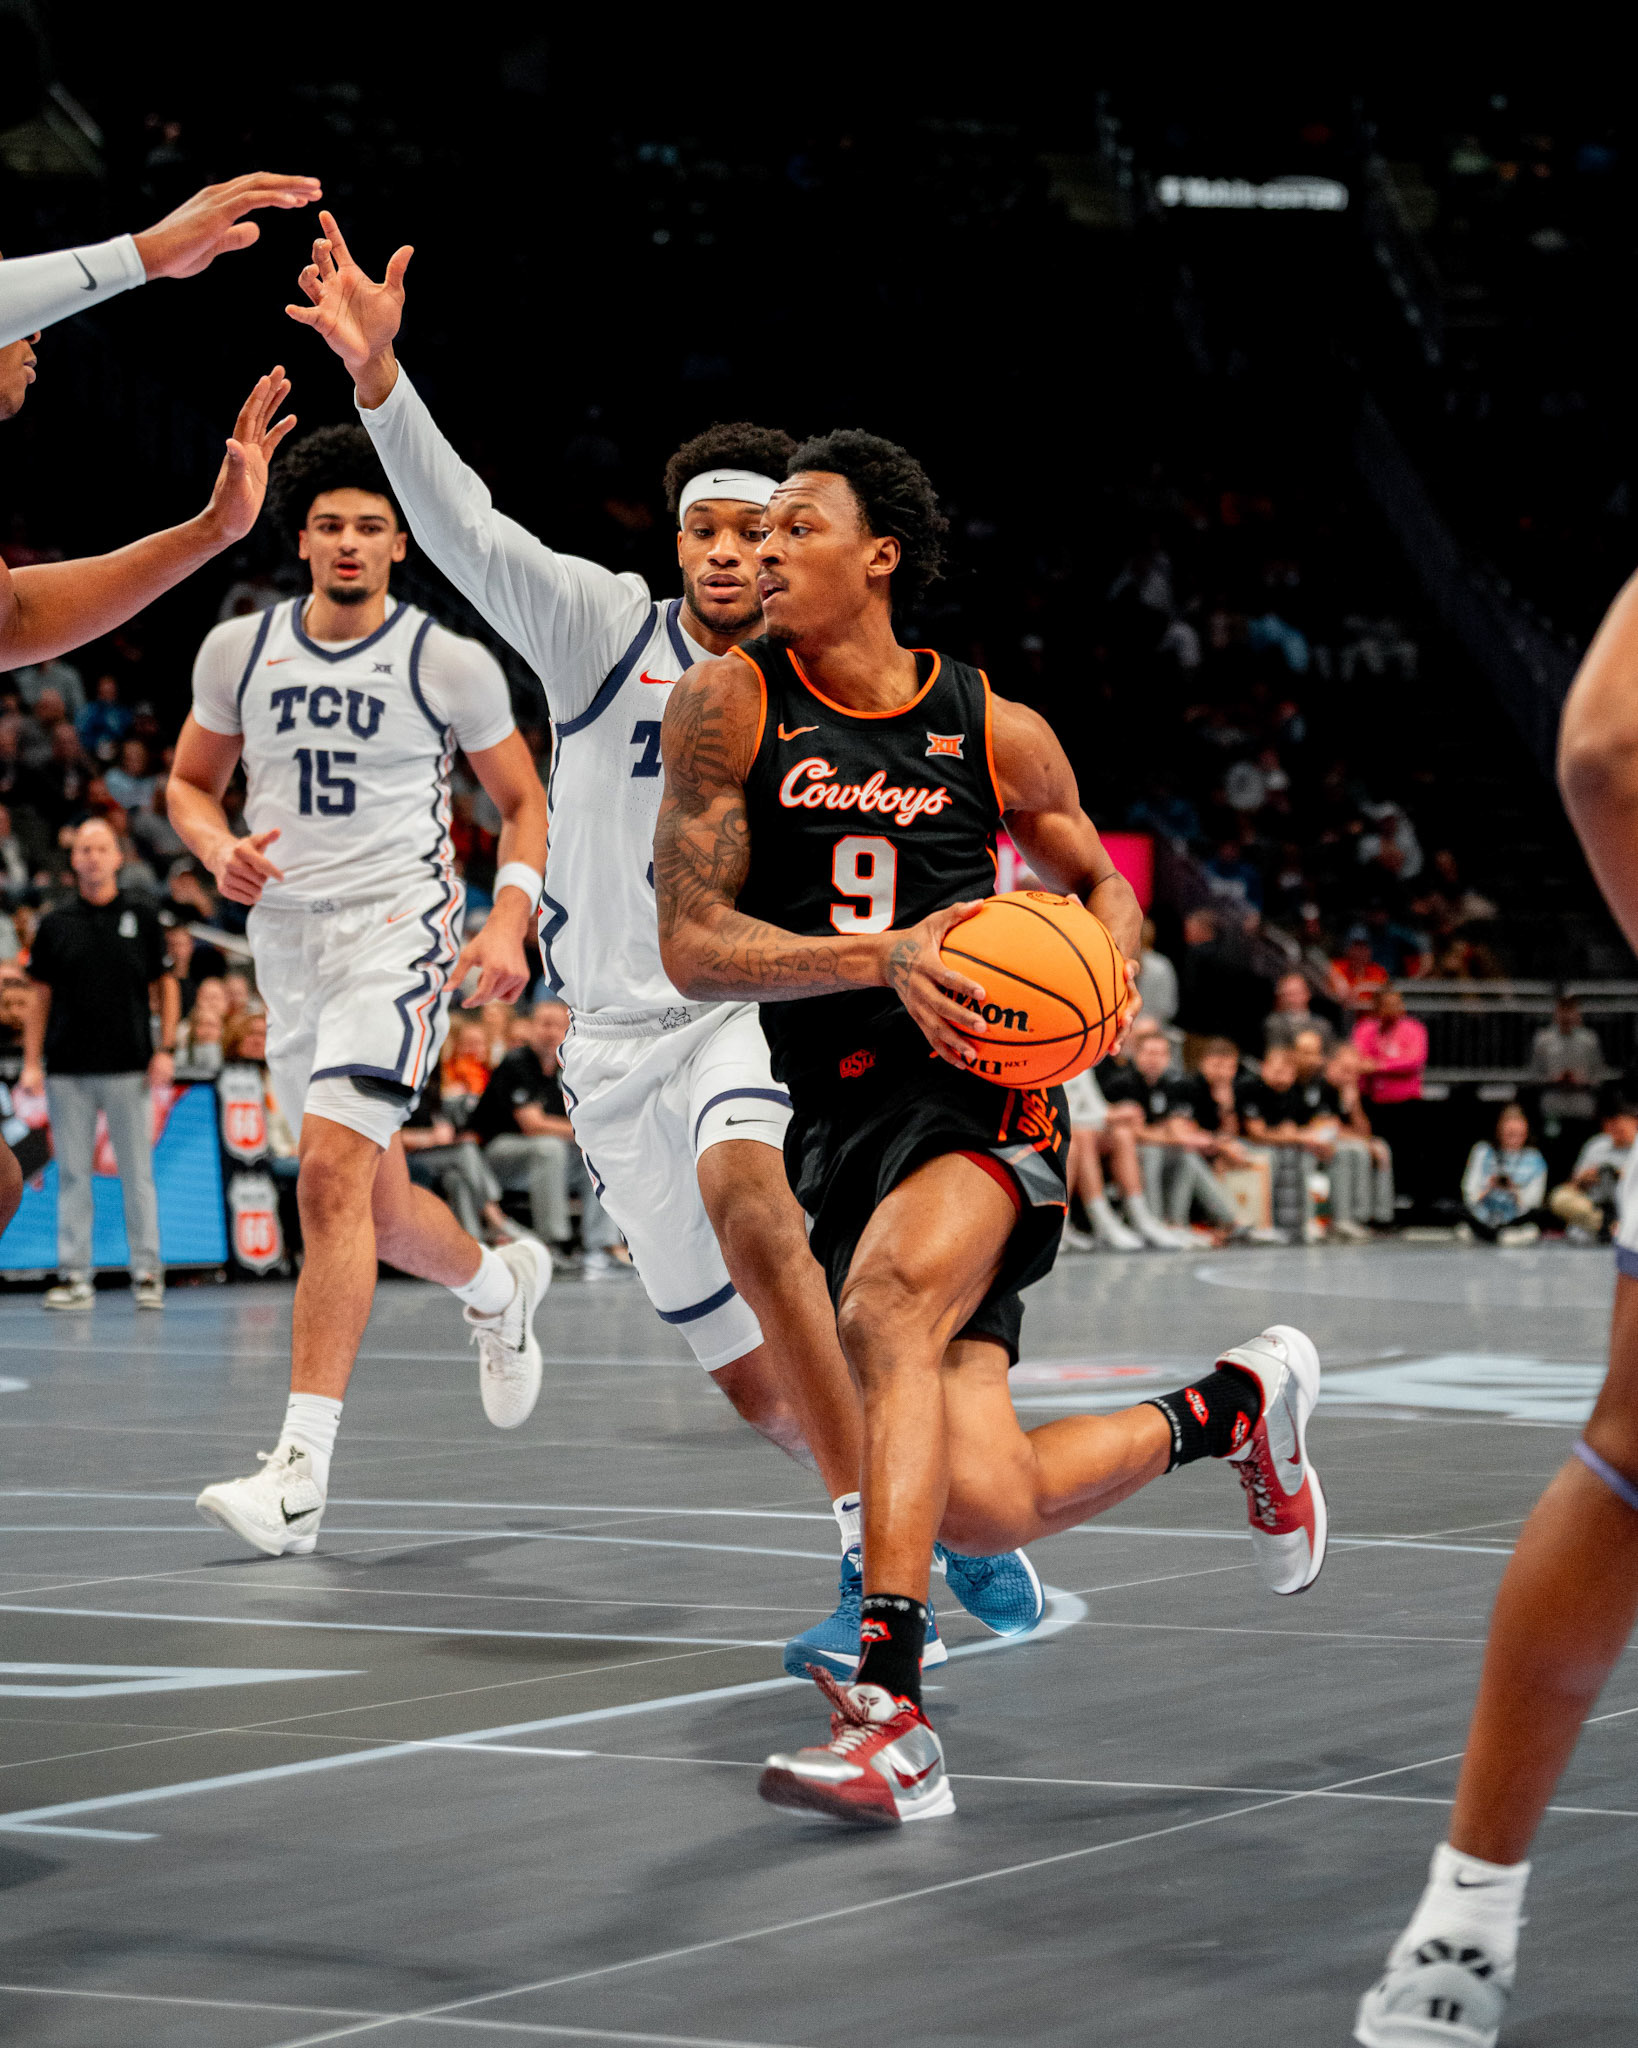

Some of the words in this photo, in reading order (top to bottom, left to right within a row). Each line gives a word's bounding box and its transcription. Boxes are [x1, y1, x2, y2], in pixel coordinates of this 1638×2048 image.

[270, 685, 386, 741] TCU
[926, 732, 964, 759] XII
[292, 748, 357, 817] 15
[778, 757, 953, 826] Cowboys
[829, 834, 898, 935] 9
[1004, 1059, 1028, 1068] NXT
